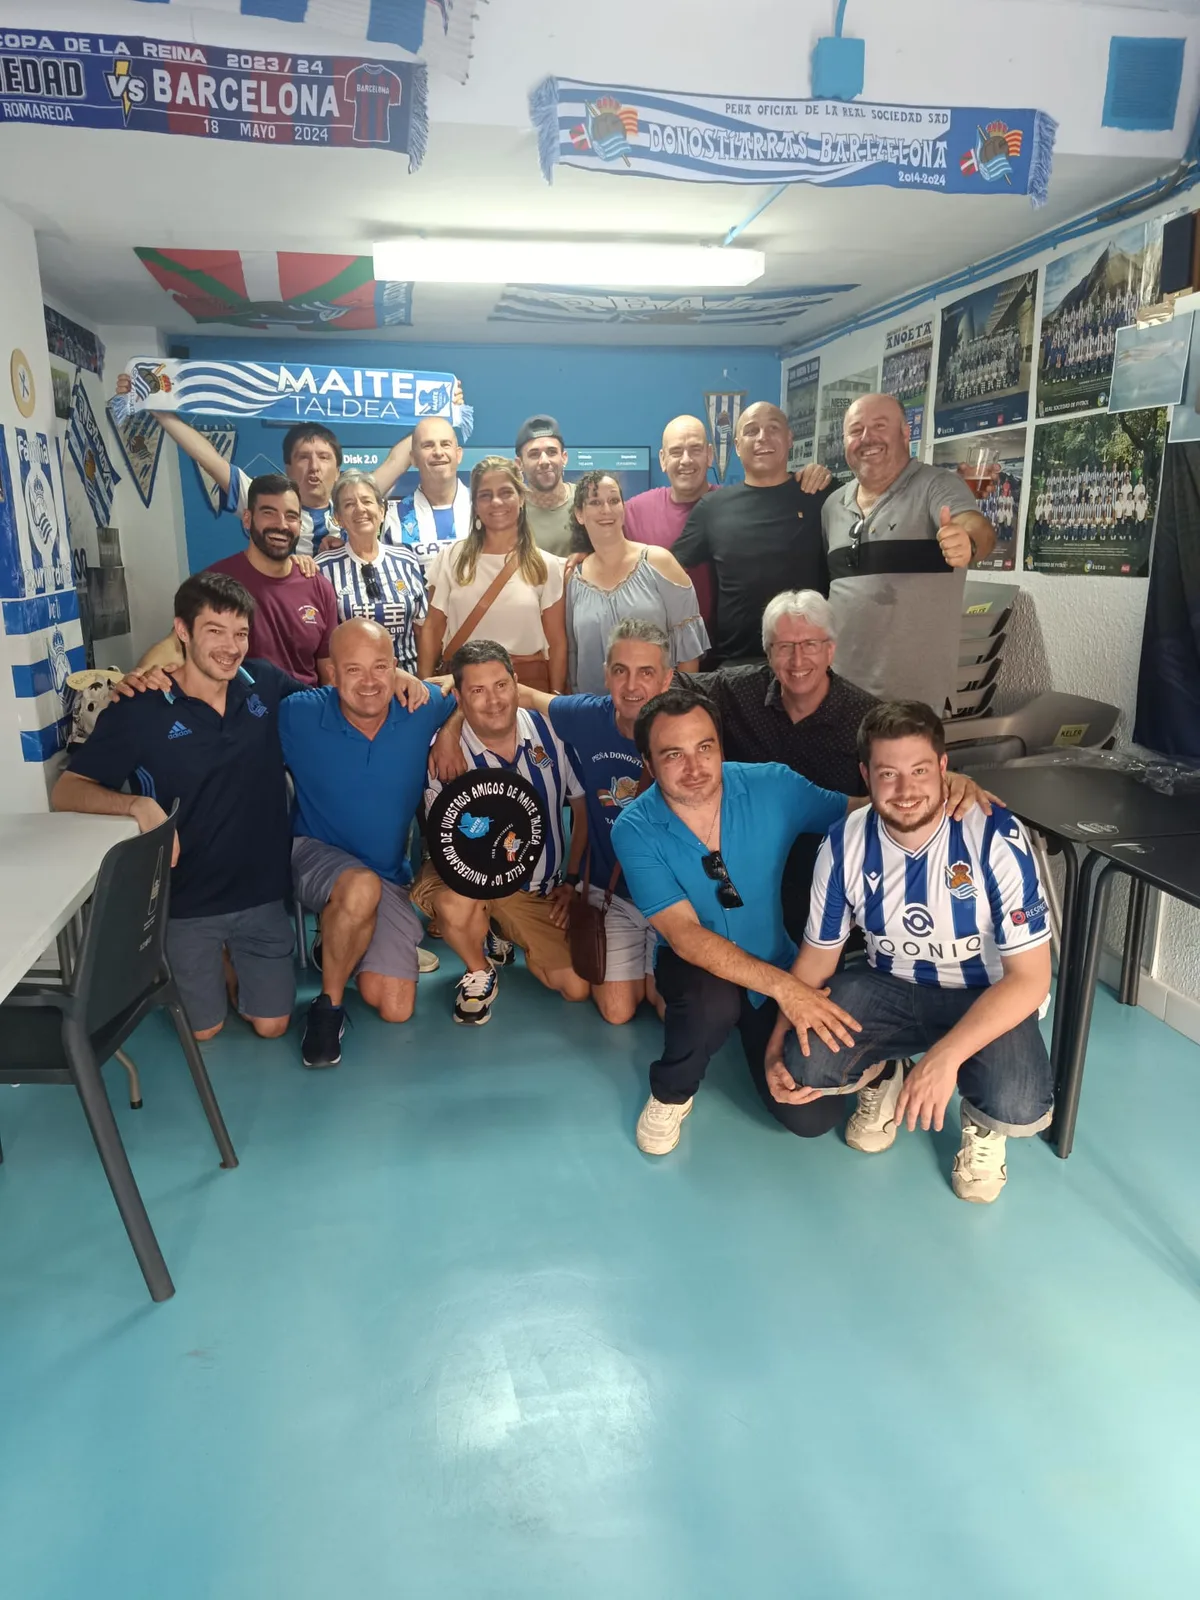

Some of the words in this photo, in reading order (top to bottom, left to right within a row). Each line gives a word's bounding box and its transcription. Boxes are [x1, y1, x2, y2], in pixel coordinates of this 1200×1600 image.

[0, 33, 55, 51] OPA
[64, 37, 91, 53] DE
[99, 39, 131, 55] LA
[142, 42, 207, 64] REINA
[0, 55, 86, 99] EDAD
[153, 68, 340, 117] BARCELONA
[356, 83, 390, 95] BARCELONA
[3, 102, 74, 121] ROMAREDA
[757, 104, 798, 116] OFICIAL
[805, 105, 819, 116] DE
[825, 104, 838, 116] LA
[842, 106, 866, 118] REAL
[871, 109, 922, 123] SOCIEDAD
[928, 113, 949, 125] SAD
[203, 119, 219, 134] 18
[240, 122, 276, 140] MAYO
[294, 125, 329, 142] 2024
[898, 170, 947, 186] 2014-2024
[885, 320, 933, 350] ANOETA
[277, 365, 414, 400] MAITE
[289, 395, 400, 420] TALDEA
[343, 454, 363, 464] Disk
[363, 454, 378, 464] 2.0
[168, 729, 193, 740] adidas
[1060, 729, 1082, 738] KELER
[471, 782, 504, 799] AMIGOS
[506, 785, 518, 799] DE
[441, 791, 471, 829] VUESTROS
[517, 791, 538, 816] MAITE
[441, 832, 453, 844] DE
[530, 815, 542, 845] TALDEA
[442, 845, 488, 886] ANIVERSARIO
[505, 863, 526, 883] FELIZ
[1025, 900, 1048, 919] RESPEC
